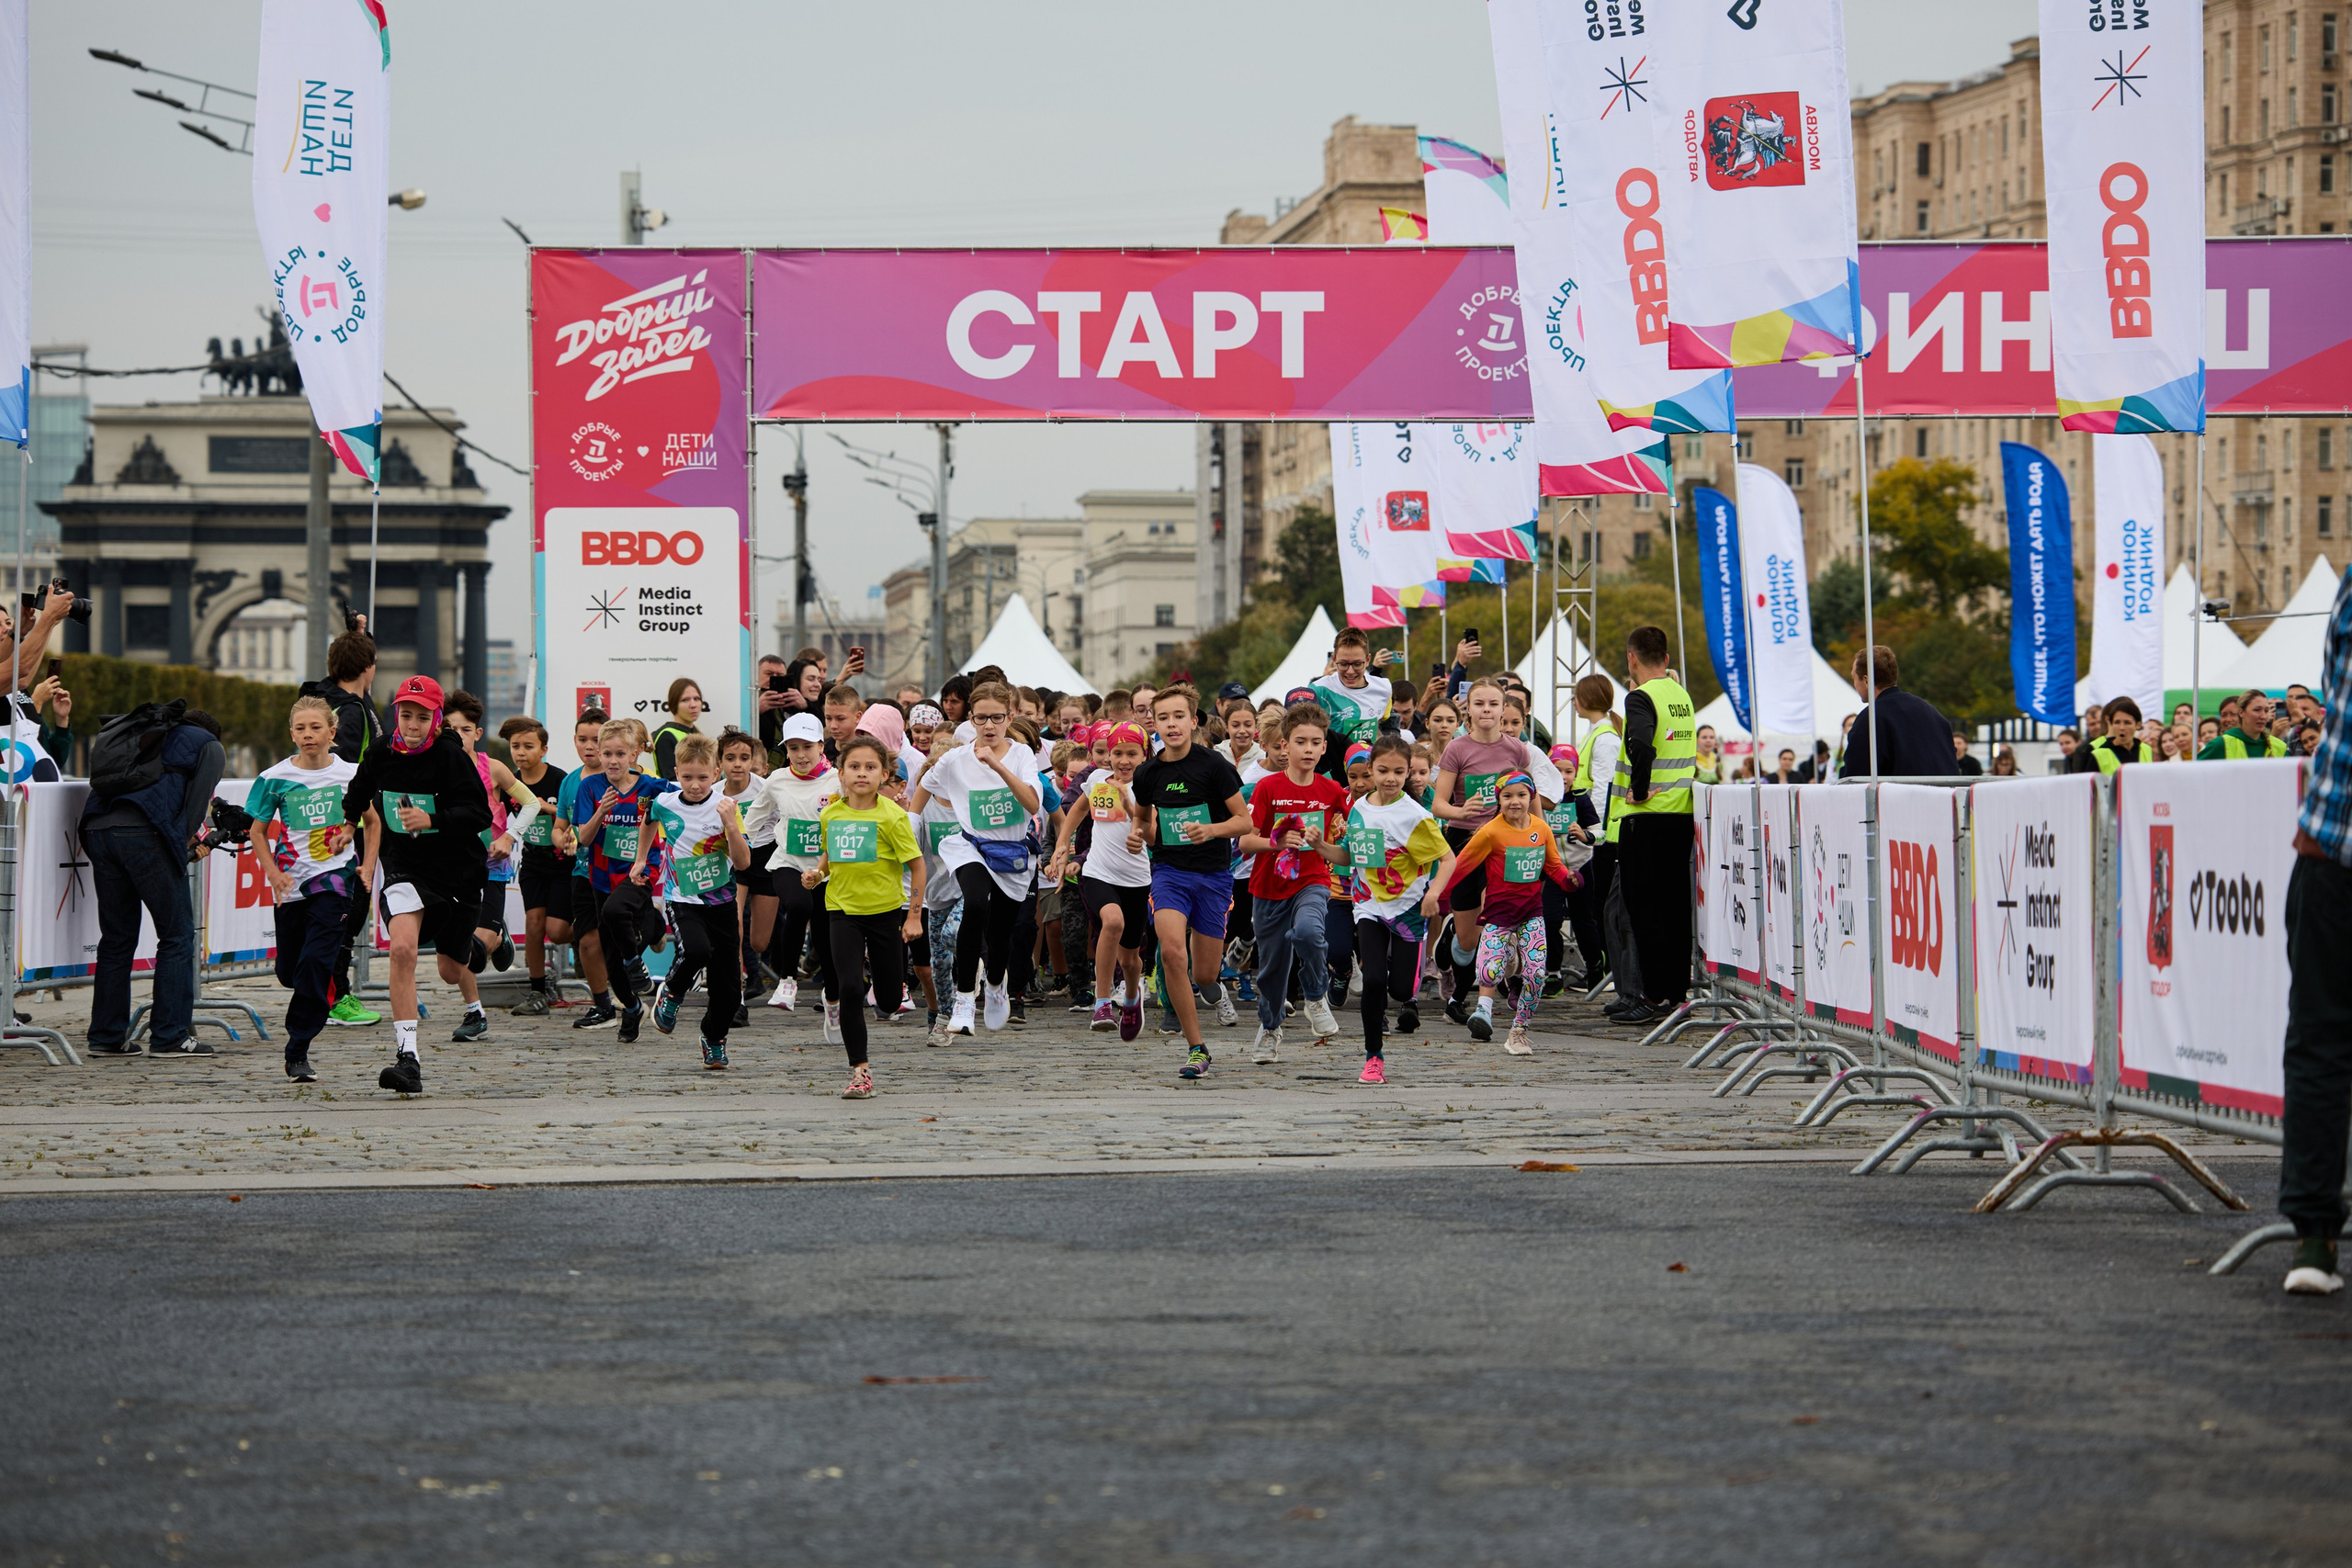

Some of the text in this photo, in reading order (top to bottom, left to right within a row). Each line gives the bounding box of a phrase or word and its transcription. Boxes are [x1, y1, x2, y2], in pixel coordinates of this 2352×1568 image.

[555, 268, 715, 367] Добрый
[945, 288, 1325, 380] СТАРТ
[585, 317, 712, 401] забег
[571, 422, 622, 445] ДОБРЫЕ
[665, 434, 714, 451] ДЕТИ
[662, 452, 718, 466] НАШИ
[569, 458, 625, 482] ПРОЕКТЫ
[582, 530, 705, 566] BBDO
[2139, 526, 2154, 614] РОДНИК
[2030, 552, 2046, 611] МОЖЕТ
[639, 587, 691, 600] Media
[1781, 558, 1800, 637] РОДНИК
[639, 603, 703, 616] Instinct
[639, 619, 690, 635] Group
[2033, 612, 2047, 646] ЧТО
[650, 699, 711, 713] Toa
[1668, 704, 1691, 719] СУДЬЯ
[1352, 729, 1374, 739] 1126
[299, 800, 334, 817] 1007
[978, 801, 1013, 817] 1038
[1092, 795, 1114, 809] 333
[834, 835, 865, 849] 1017
[1348, 841, 1375, 854] 1043
[2025, 820, 2055, 869] Media
[686, 865, 720, 882] 1045
[1515, 859, 1543, 871] 1005
[1889, 840, 1943, 977] BBDO
[2206, 869, 2265, 937] Tooba
